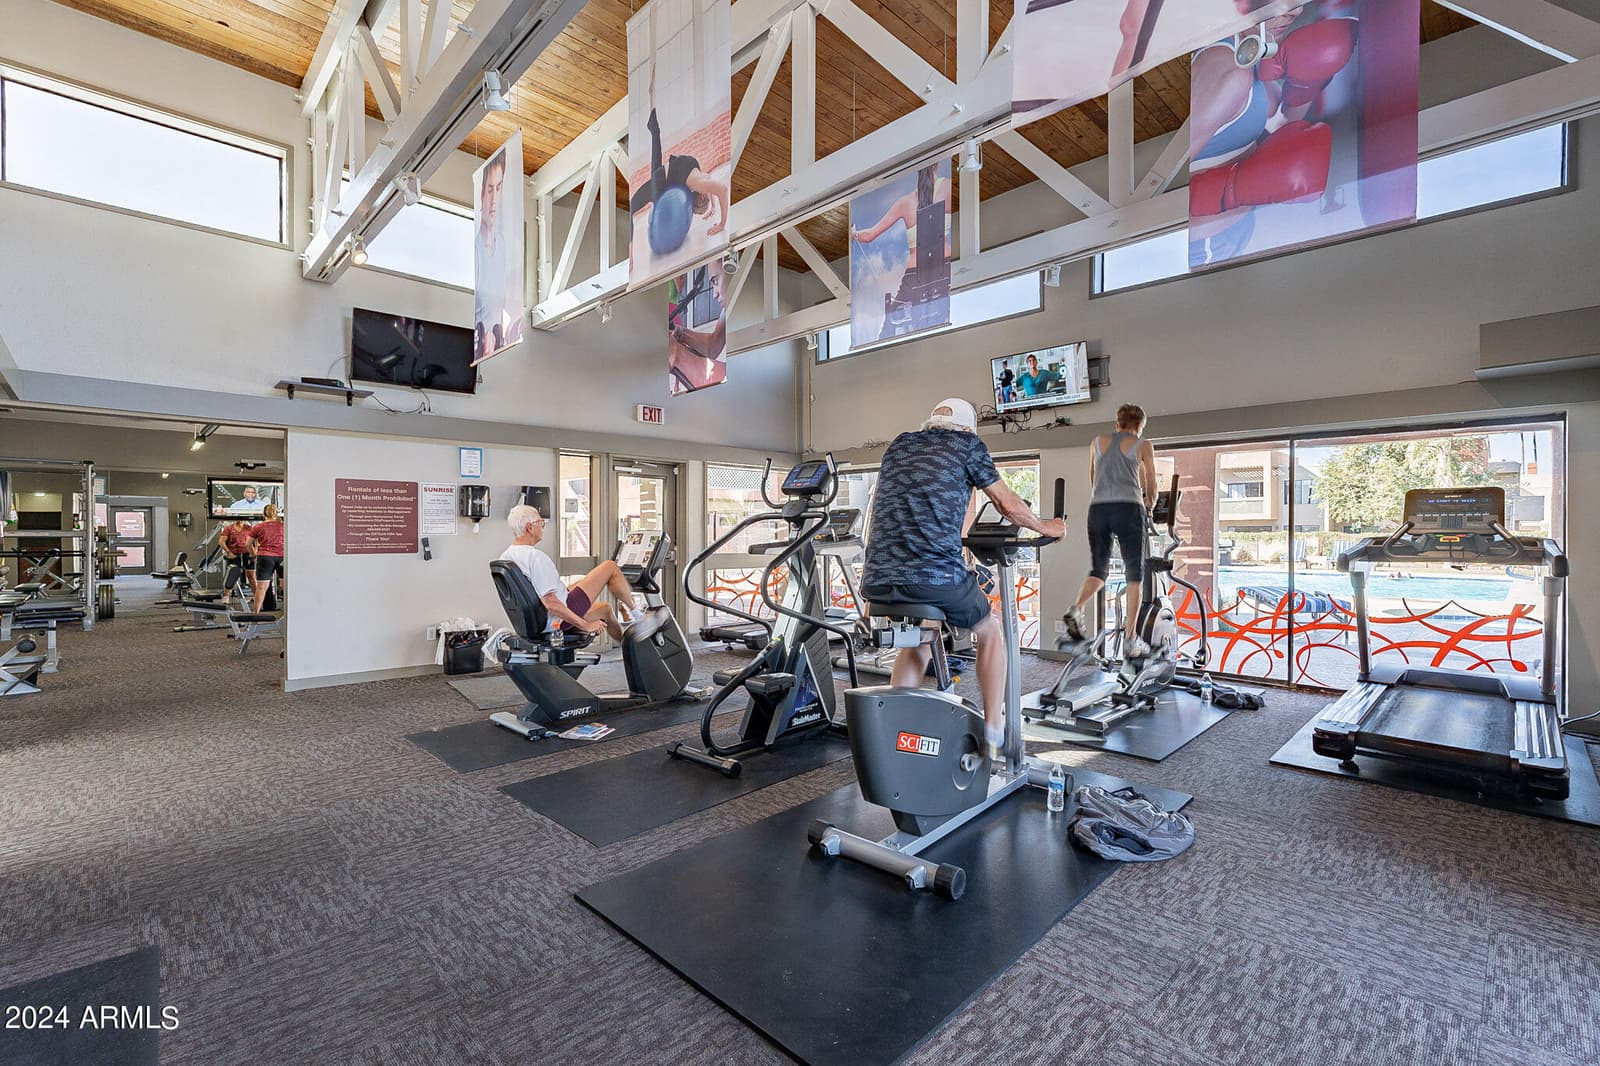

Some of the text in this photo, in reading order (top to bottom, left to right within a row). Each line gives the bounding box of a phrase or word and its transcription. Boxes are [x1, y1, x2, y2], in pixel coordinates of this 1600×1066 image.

[643, 406, 662, 423] EXIT
[560, 705, 592, 719] SPIRIT
[899, 735, 939, 753] SCIFIT
